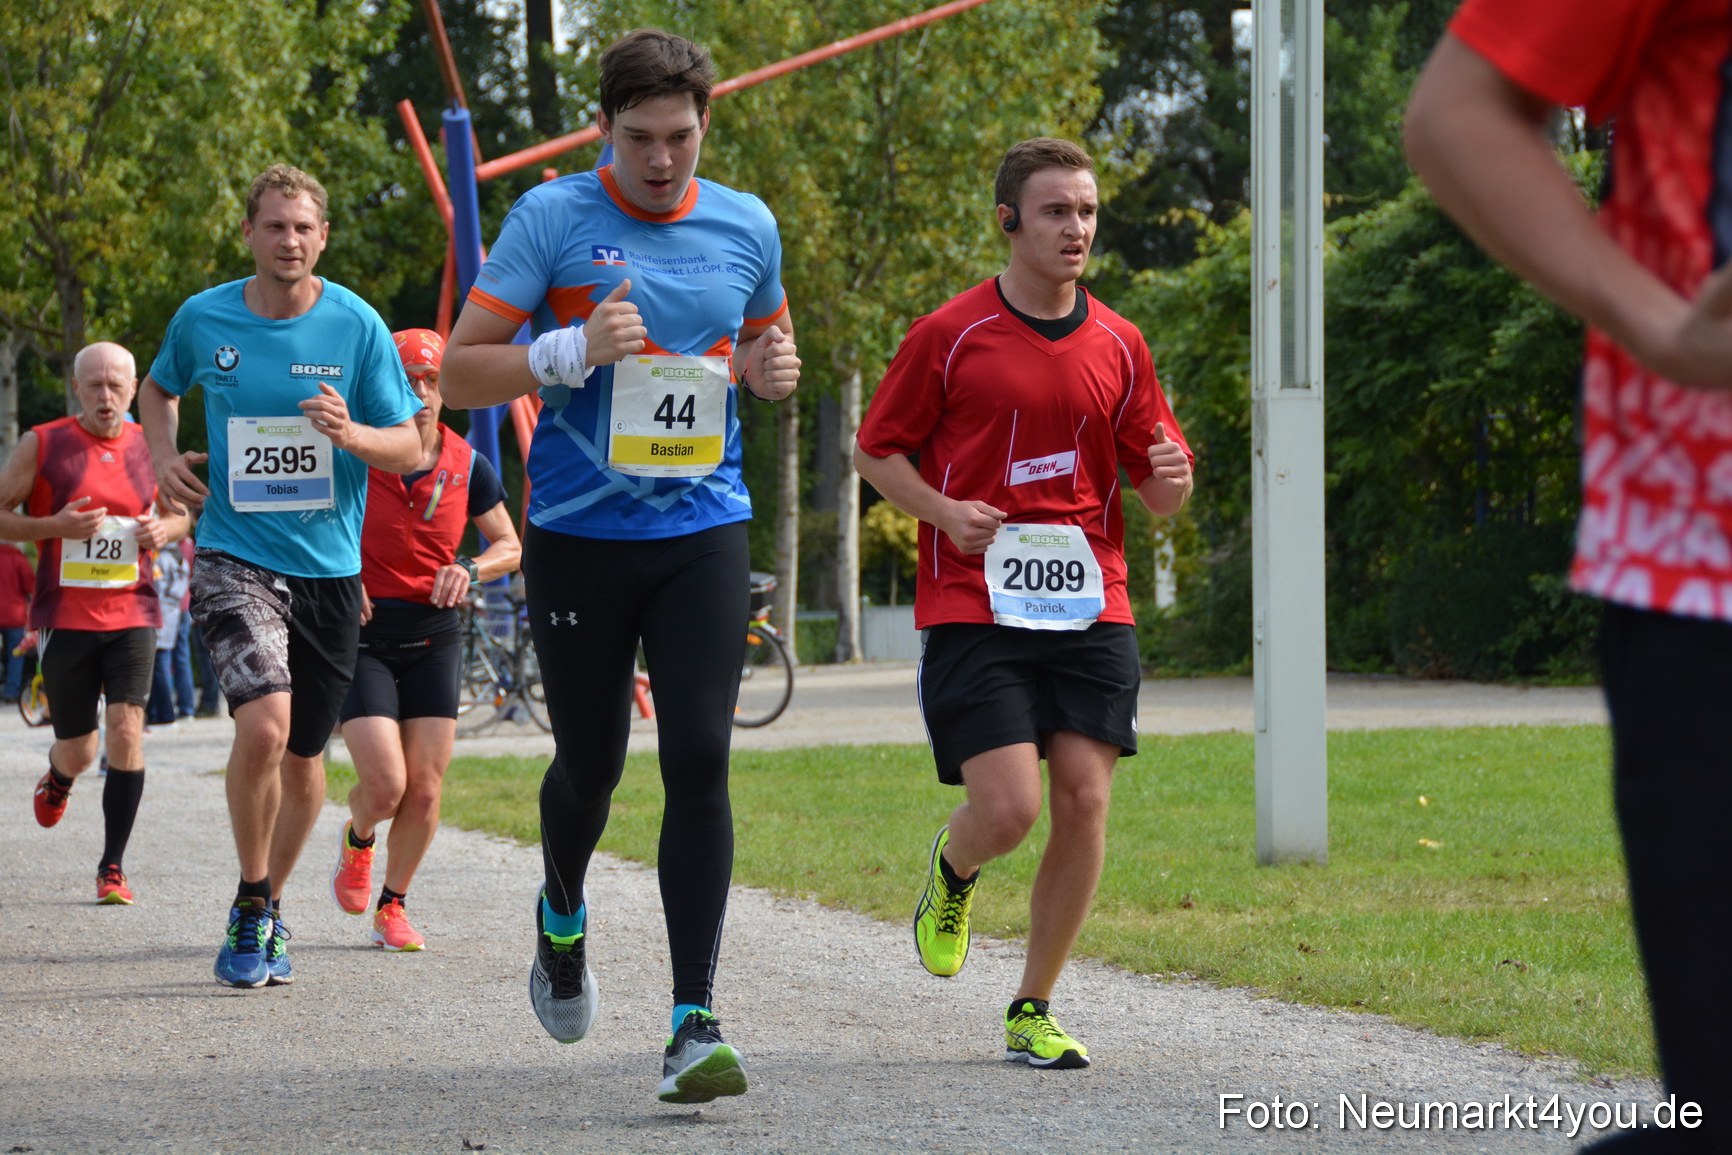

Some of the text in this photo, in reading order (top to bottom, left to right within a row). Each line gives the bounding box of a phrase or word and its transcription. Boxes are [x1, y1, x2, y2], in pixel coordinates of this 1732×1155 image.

[629, 251, 708, 265] Raiffeisenbank
[631, 260, 685, 276] Neumarkt
[726, 265, 739, 275] eG
[290, 363, 343, 377] BOCK
[664, 368, 704, 378] BOCK
[214, 374, 239, 383] PARTL
[653, 394, 696, 430] 44
[267, 426, 302, 434] BOCK
[650, 443, 694, 456] Bastian
[244, 445, 317, 475] 2595
[1028, 461, 1058, 475] DEHN
[265, 484, 299, 495] Tobias
[1031, 535, 1069, 545] BOCK
[82, 537, 122, 560] 128
[91, 567, 110, 576] Peter
[1002, 558, 1085, 593] 2089
[1025, 601, 1066, 614] Patrick
